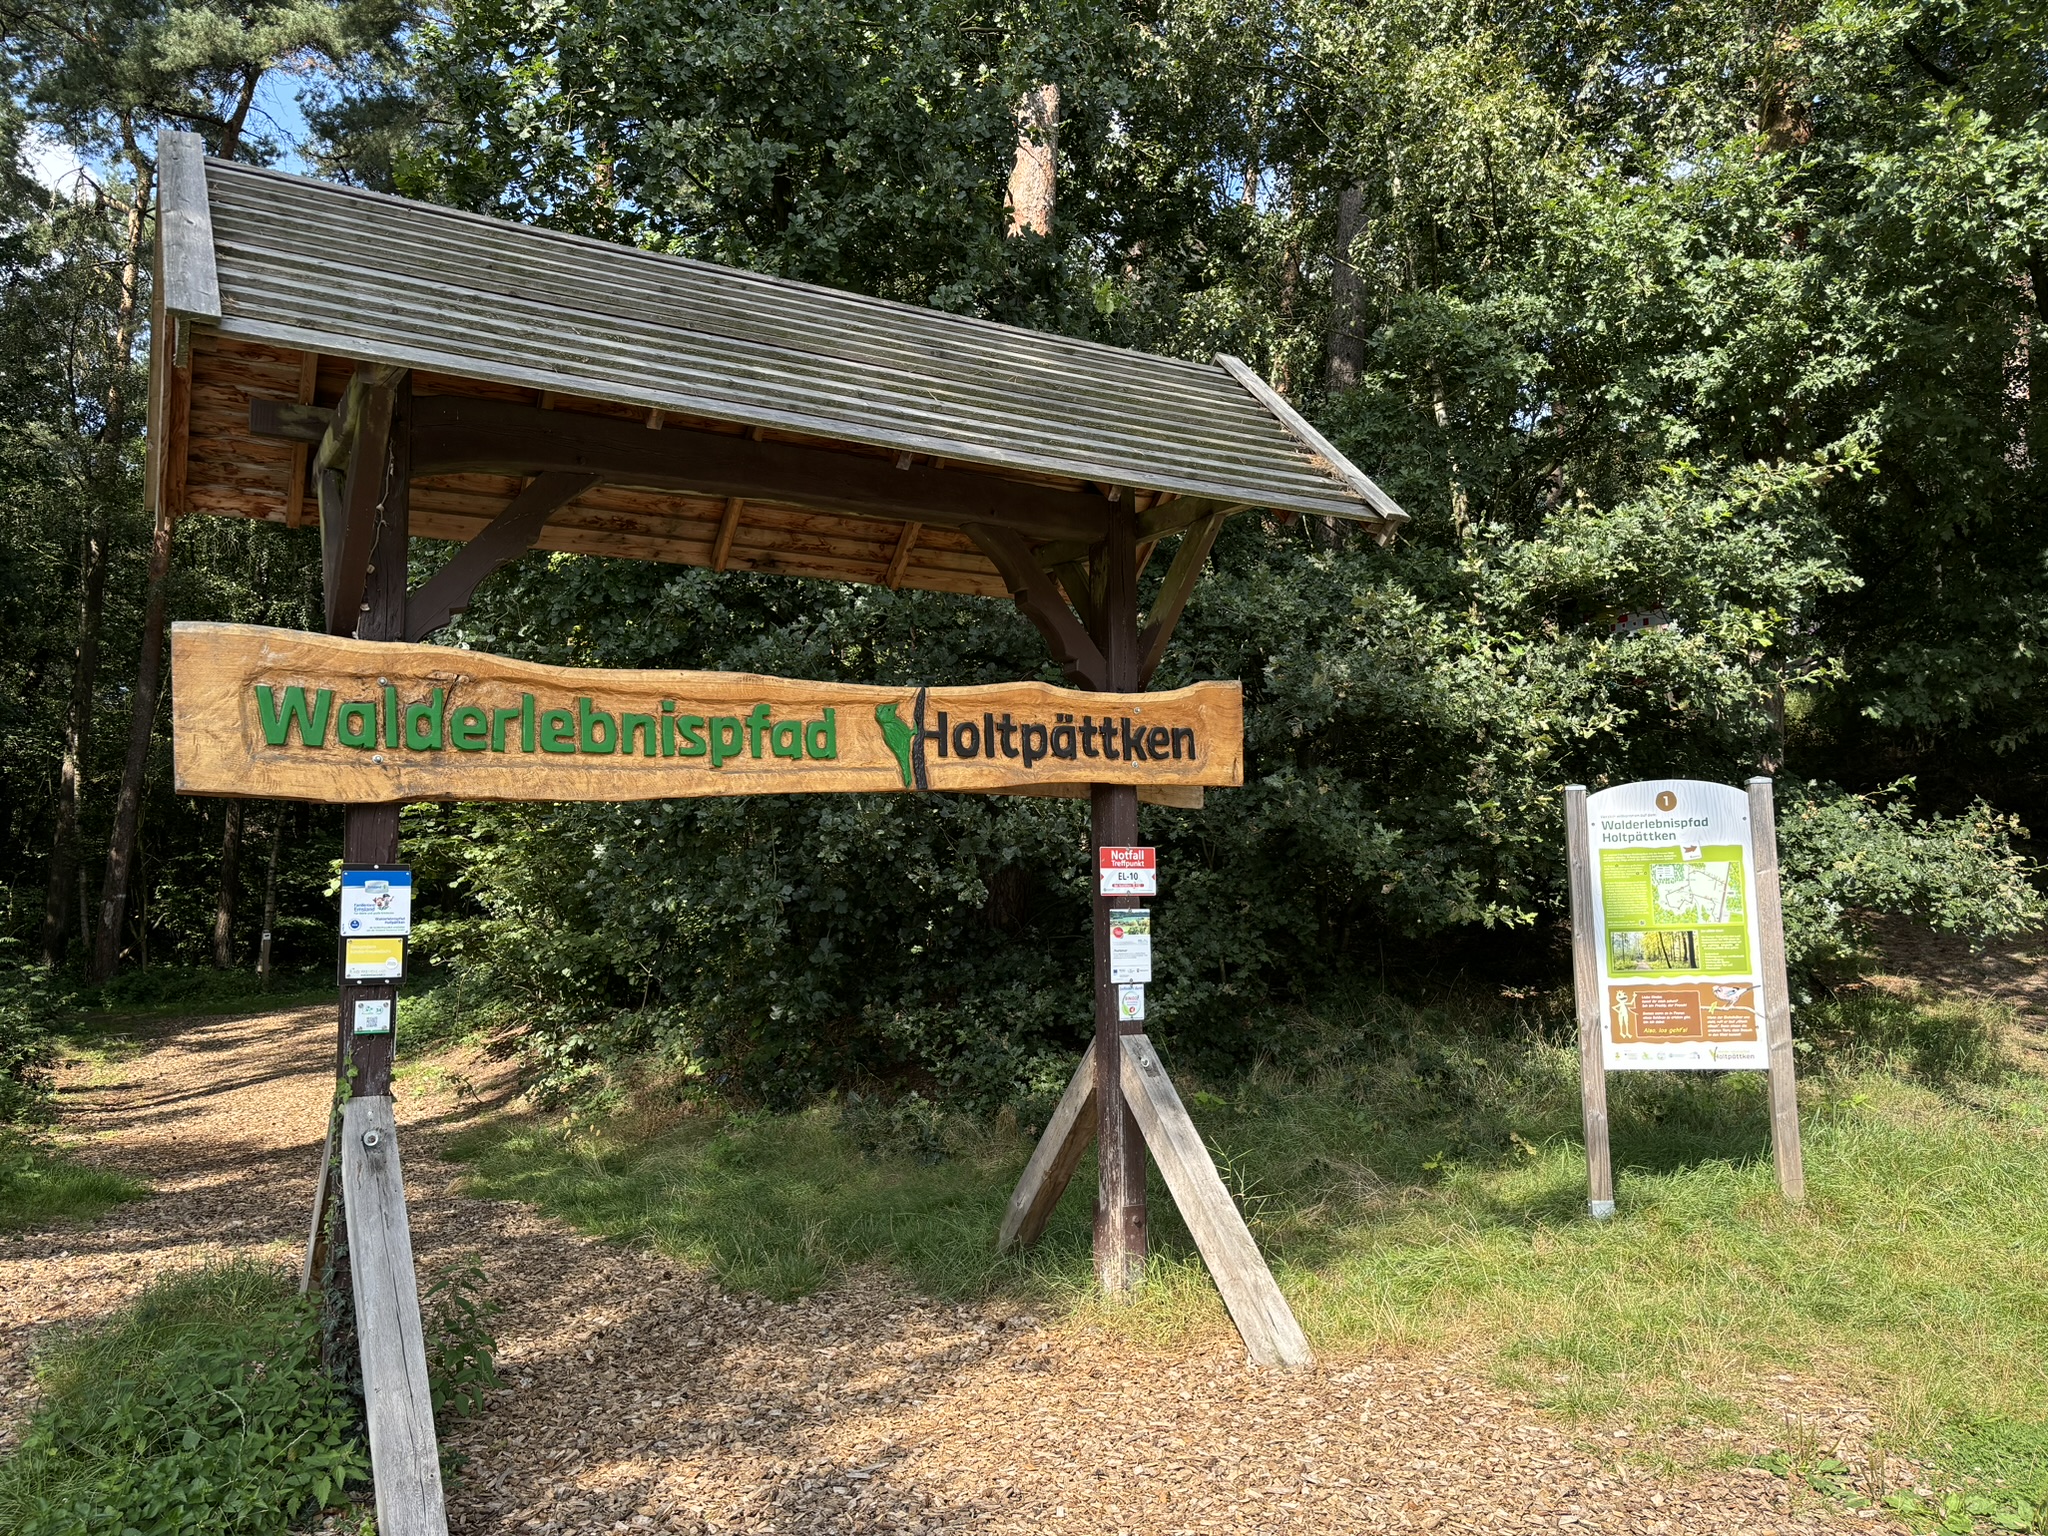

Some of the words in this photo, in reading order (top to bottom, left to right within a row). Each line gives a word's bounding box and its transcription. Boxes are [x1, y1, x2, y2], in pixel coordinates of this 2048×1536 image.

[255, 684, 836, 768] Walderlebnispfad
[922, 709, 1197, 768] Holtpättken
[1662, 795, 1669, 807] 1
[1601, 817, 1709, 831] Walderlebnispfad
[1602, 831, 1677, 844] Holtpättken
[1111, 850, 1145, 860] Notfall
[1111, 860, 1145, 868] Treffpunkt
[1118, 872, 1139, 881] EL-10
